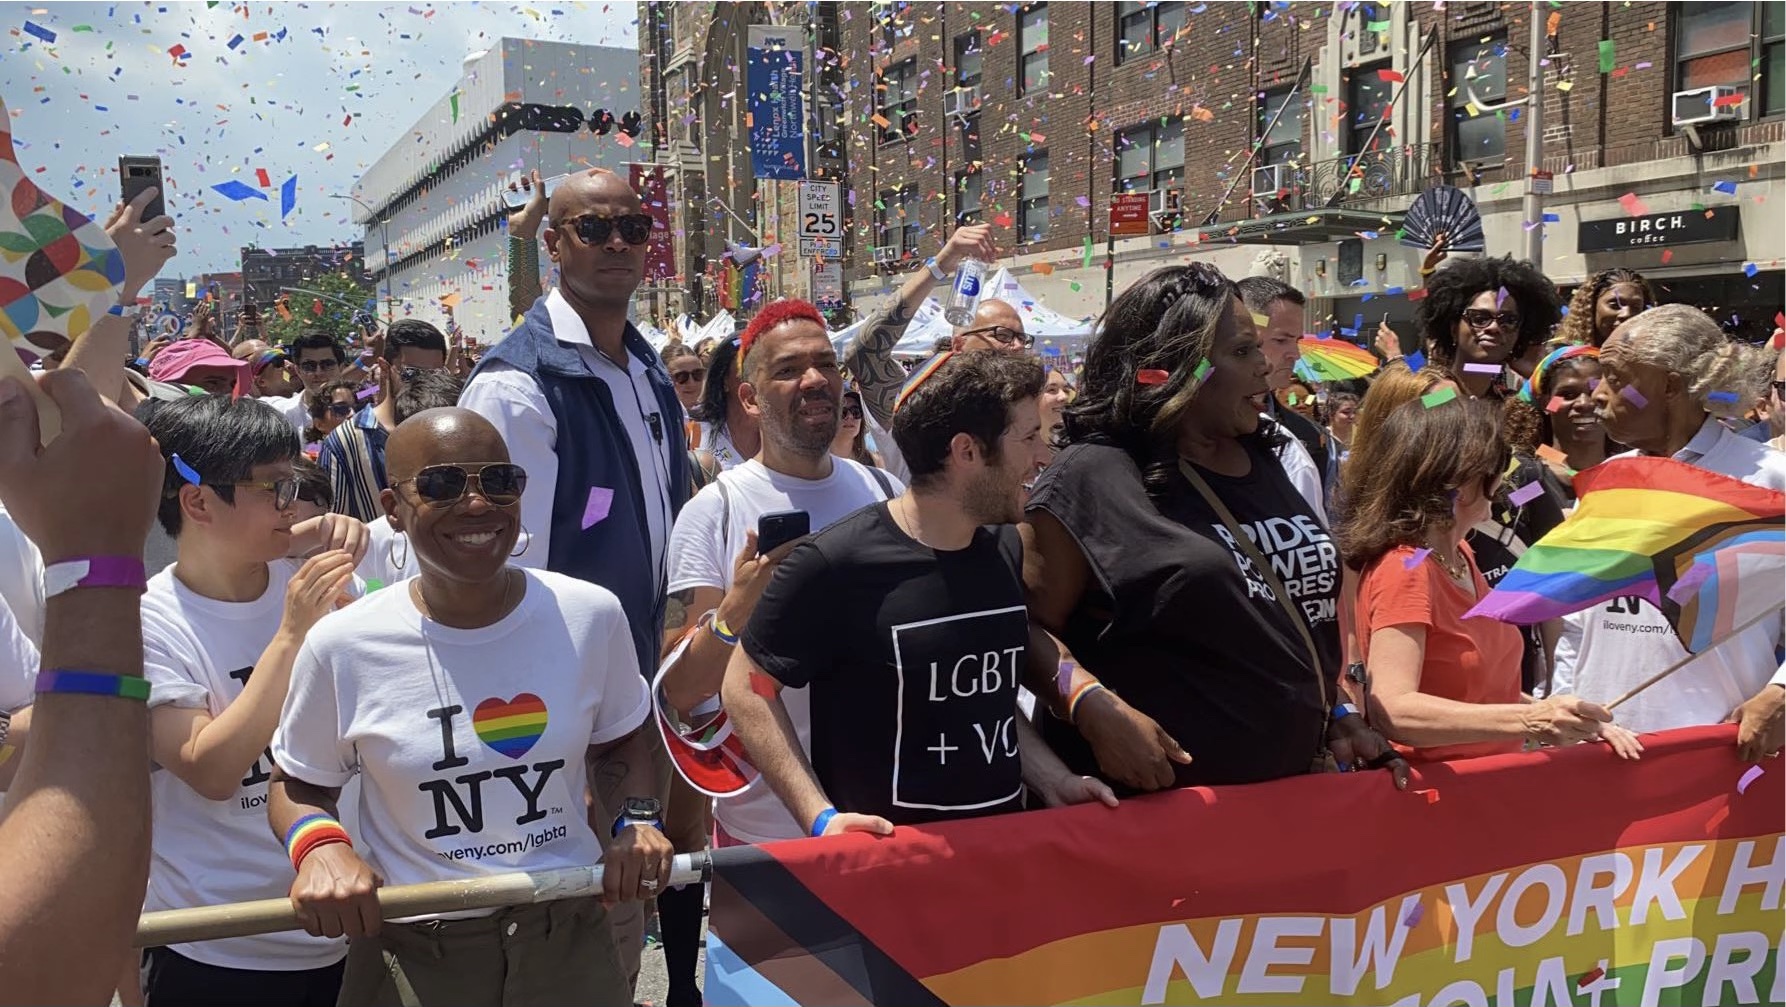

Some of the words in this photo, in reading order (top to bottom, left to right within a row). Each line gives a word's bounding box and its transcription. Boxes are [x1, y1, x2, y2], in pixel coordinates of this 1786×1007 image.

[805, 212, 836, 234] 25
[1482, 565, 1509, 580] TRA
[1603, 620, 1677, 635] iloveny.com/l
[929, 646, 1024, 701] LGBT
[427, 704, 469, 771] I
[927, 733, 958, 764] +
[418, 759, 565, 840] NY
[1141, 892, 1420, 1005] NEW
[1445, 844, 1704, 964] YORK
